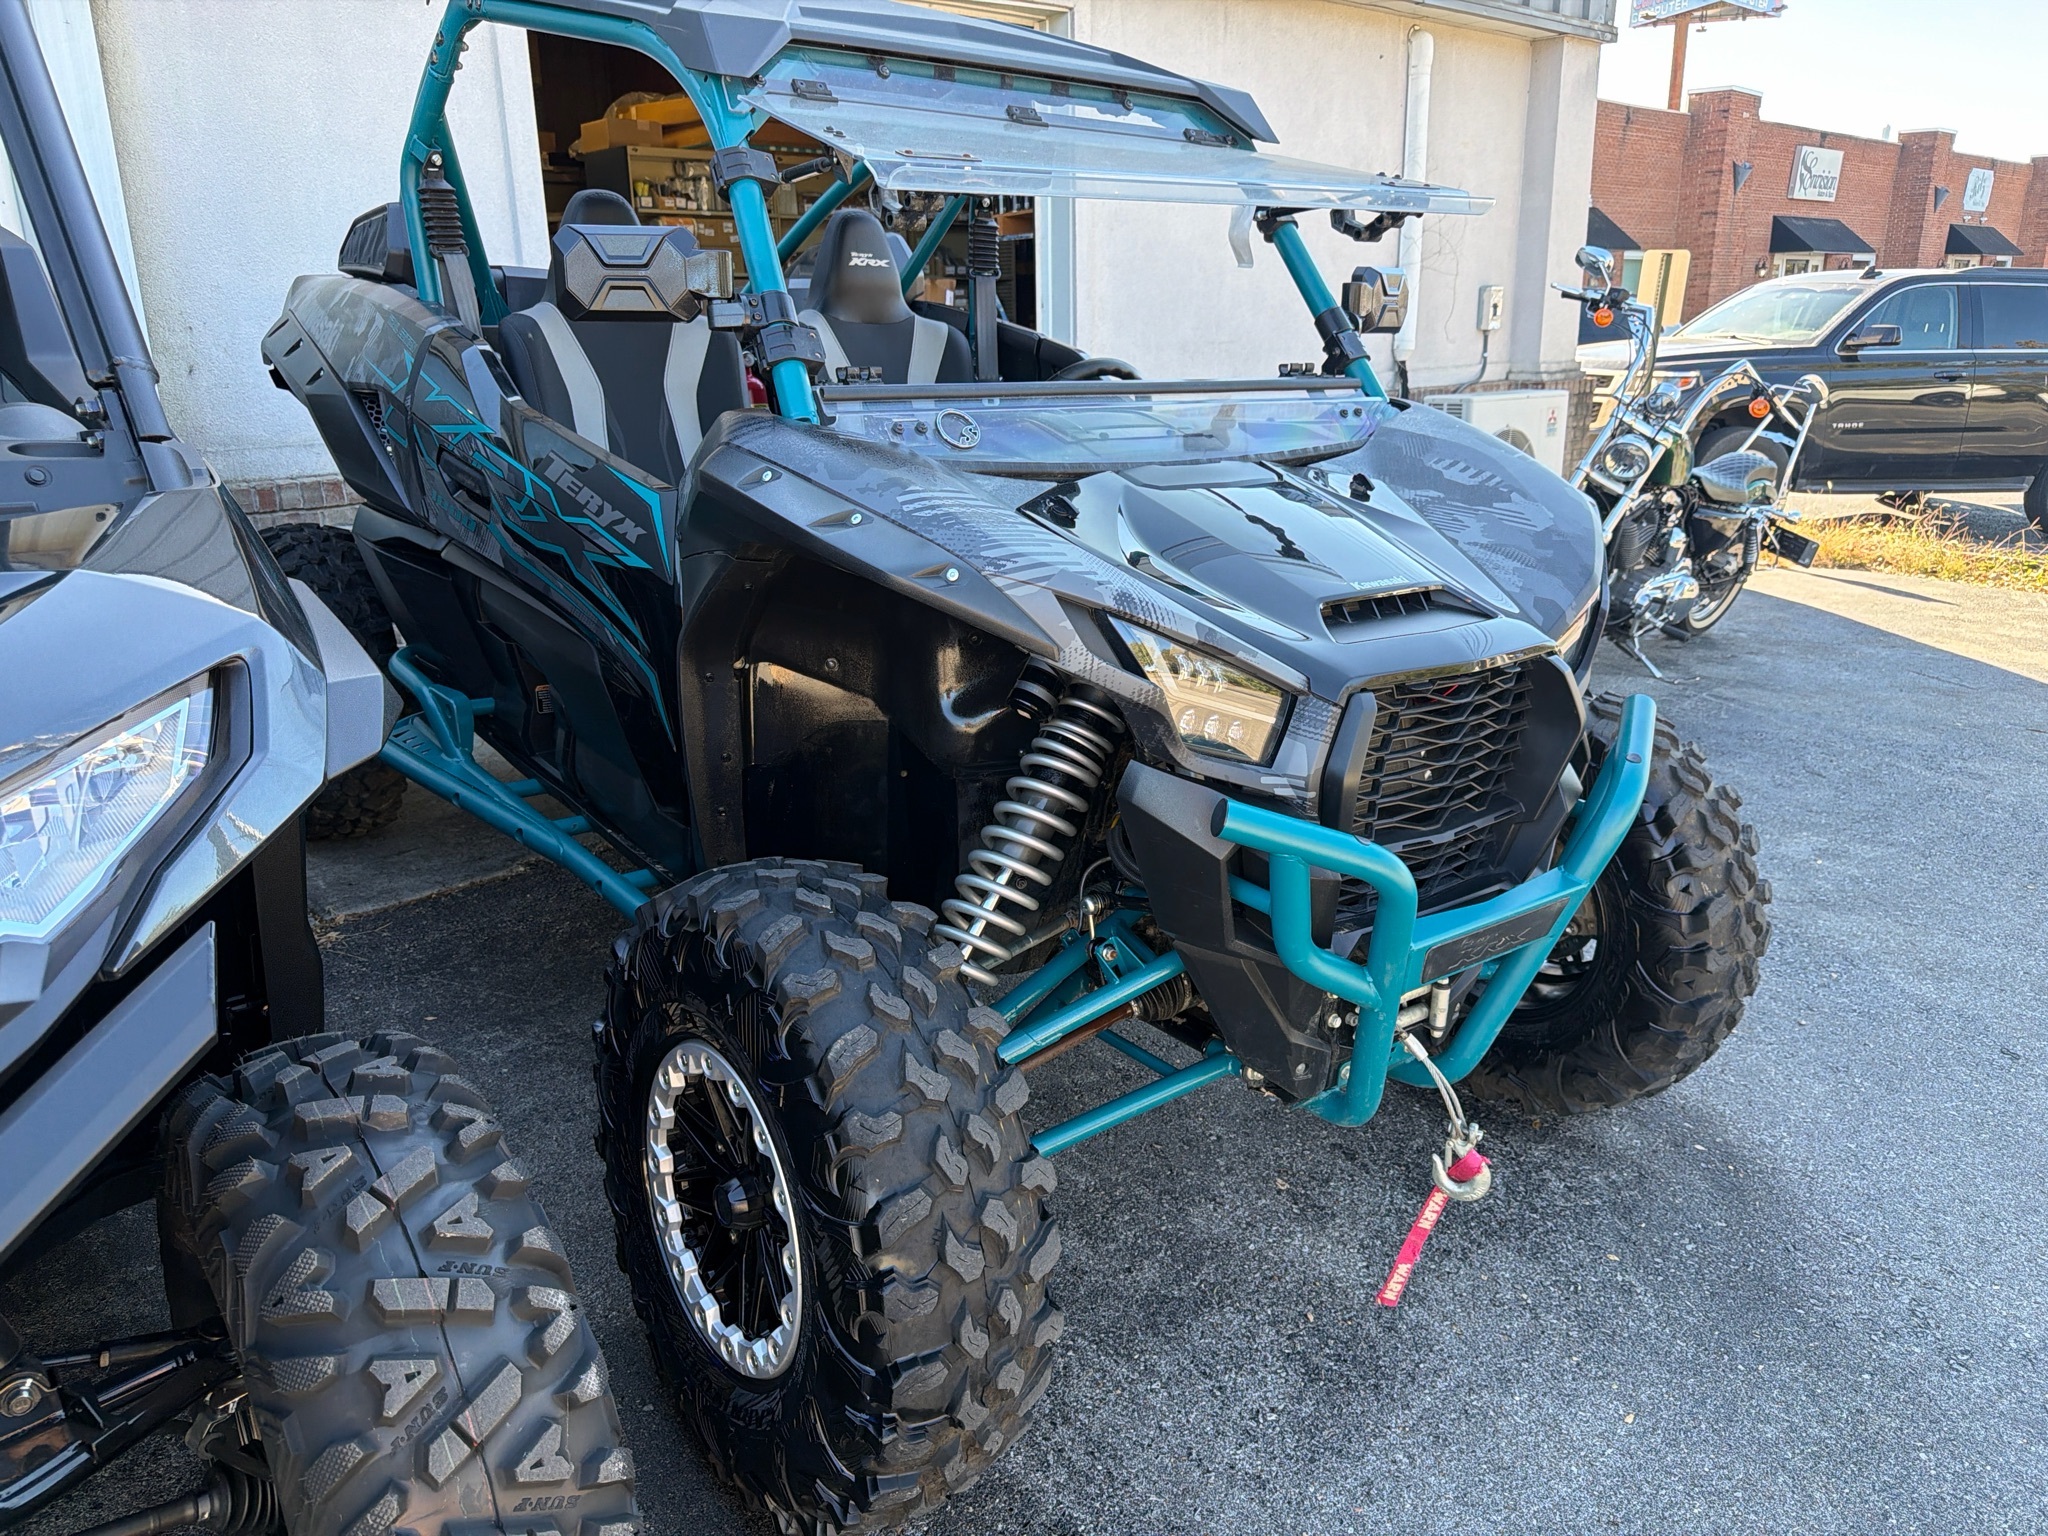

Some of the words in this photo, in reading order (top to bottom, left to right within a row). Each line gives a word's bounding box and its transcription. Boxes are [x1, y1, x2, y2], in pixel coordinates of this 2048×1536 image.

[848, 257, 890, 267] KRX
[1831, 421, 1864, 429] TAHOE
[543, 450, 648, 545] TERYX
[1417, 1191, 1449, 1230] WARN
[1382, 1263, 1412, 1301] WARN
